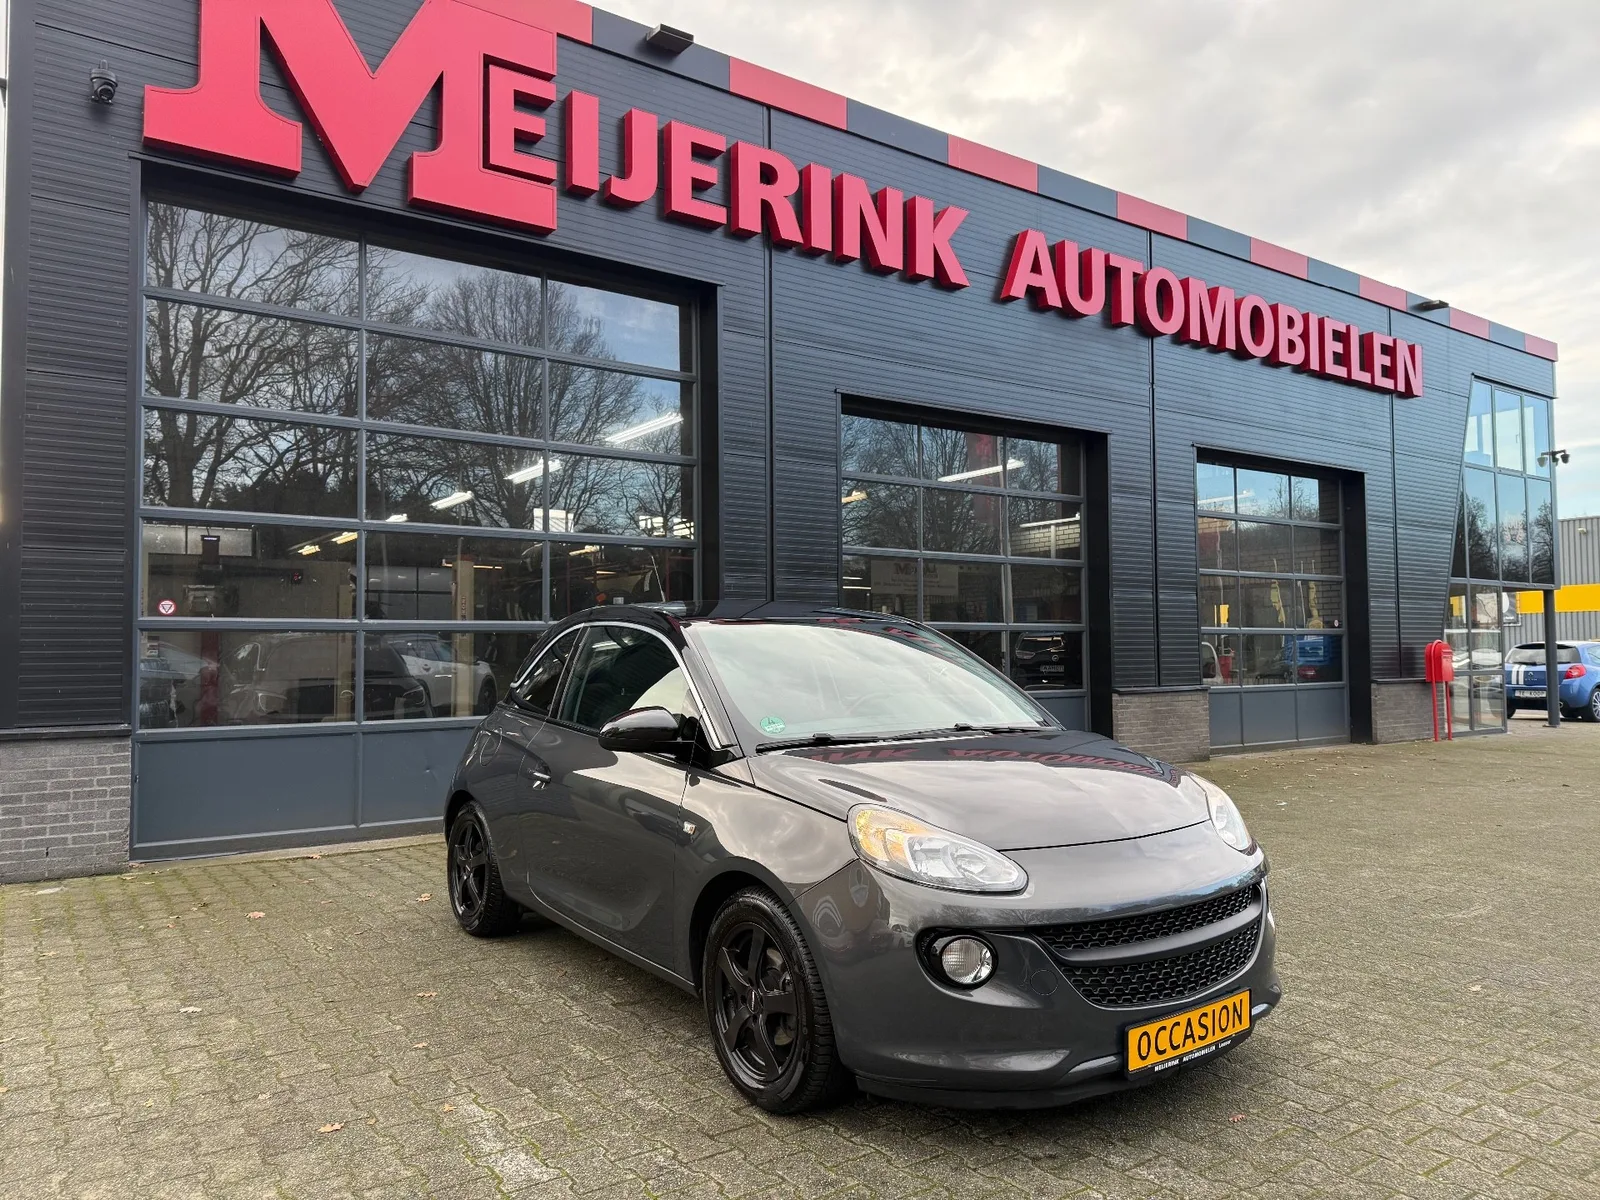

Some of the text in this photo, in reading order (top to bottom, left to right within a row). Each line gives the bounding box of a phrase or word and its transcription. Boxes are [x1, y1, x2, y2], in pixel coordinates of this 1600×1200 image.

[143, 0, 1423, 398] MEIJERINK AUTOMOBIELEN
[1137, 999, 1243, 1060] OCCASION
[1154, 1059, 1180, 1072] MEIJERINK
[1182, 1045, 1216, 1062] AUTOMOBIELEN
